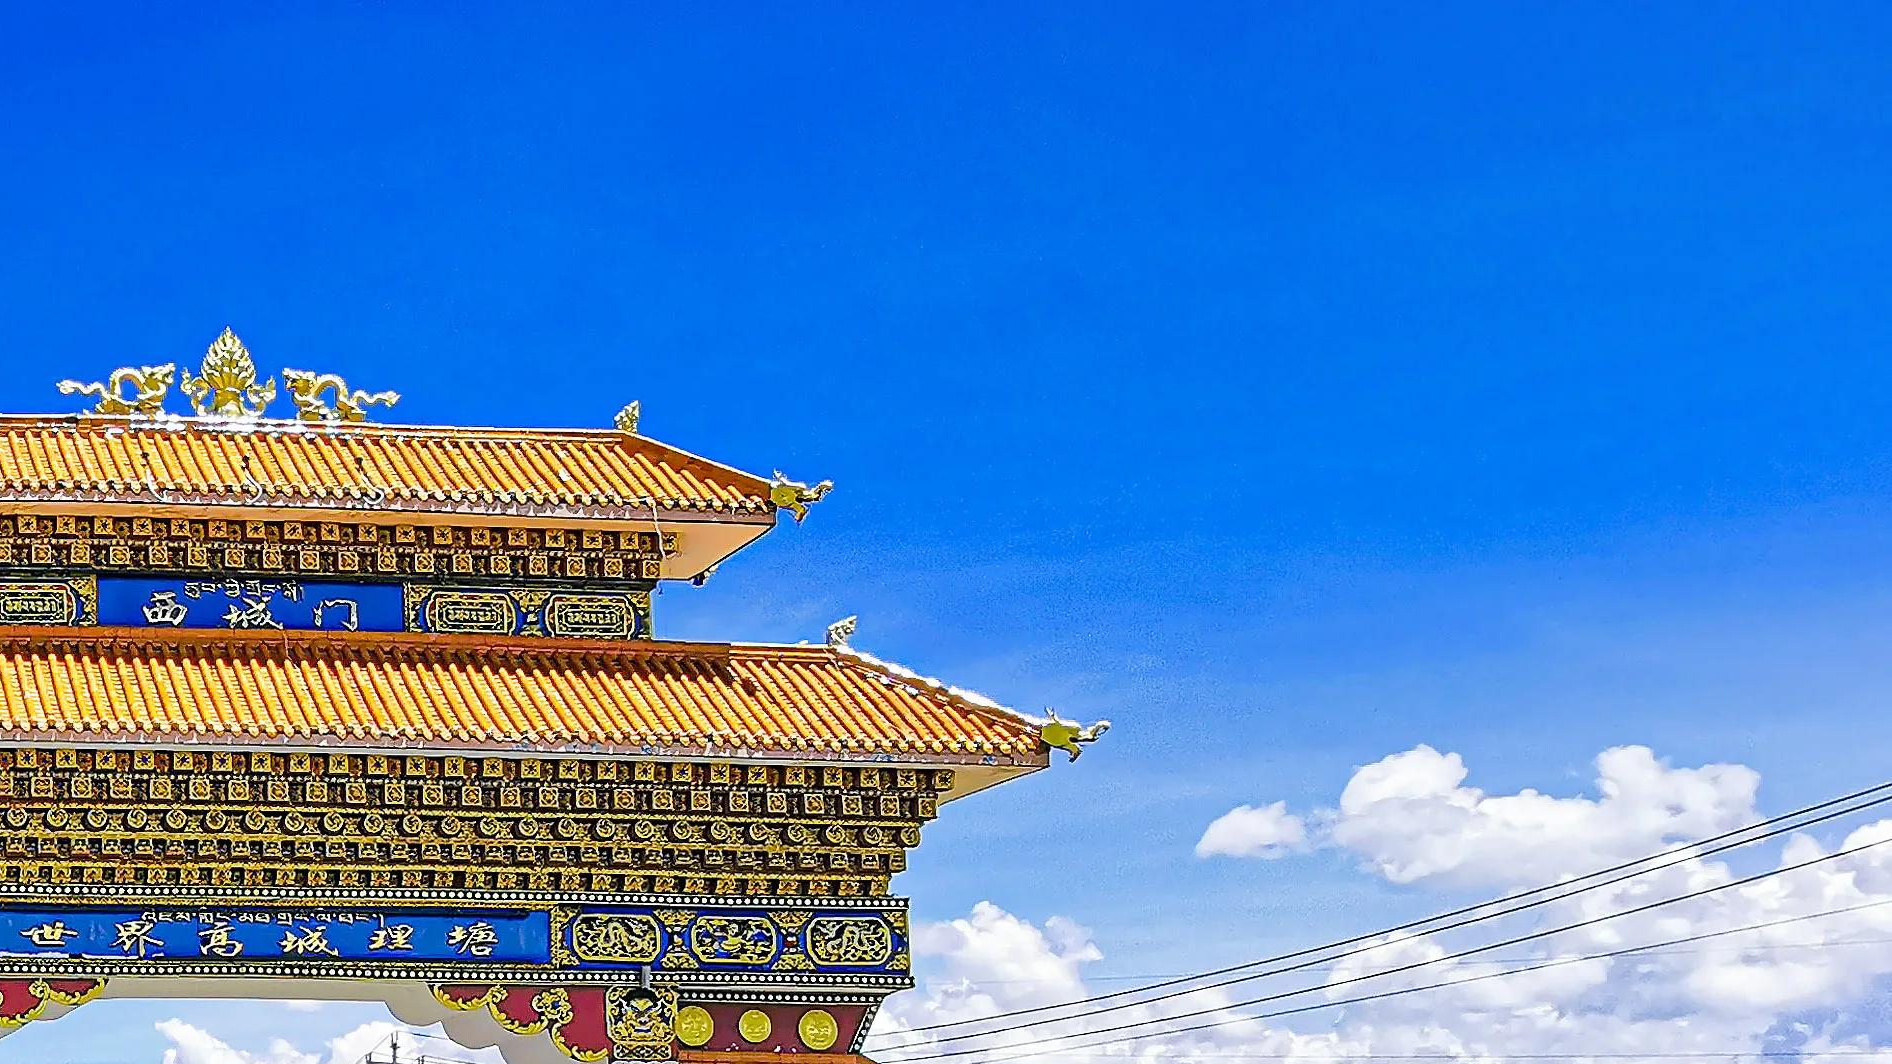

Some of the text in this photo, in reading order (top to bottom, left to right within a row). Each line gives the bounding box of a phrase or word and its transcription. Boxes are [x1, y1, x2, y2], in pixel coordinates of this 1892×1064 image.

[142, 589, 359, 631] 西城门
[19, 921, 500, 959] 世界高城理塘
